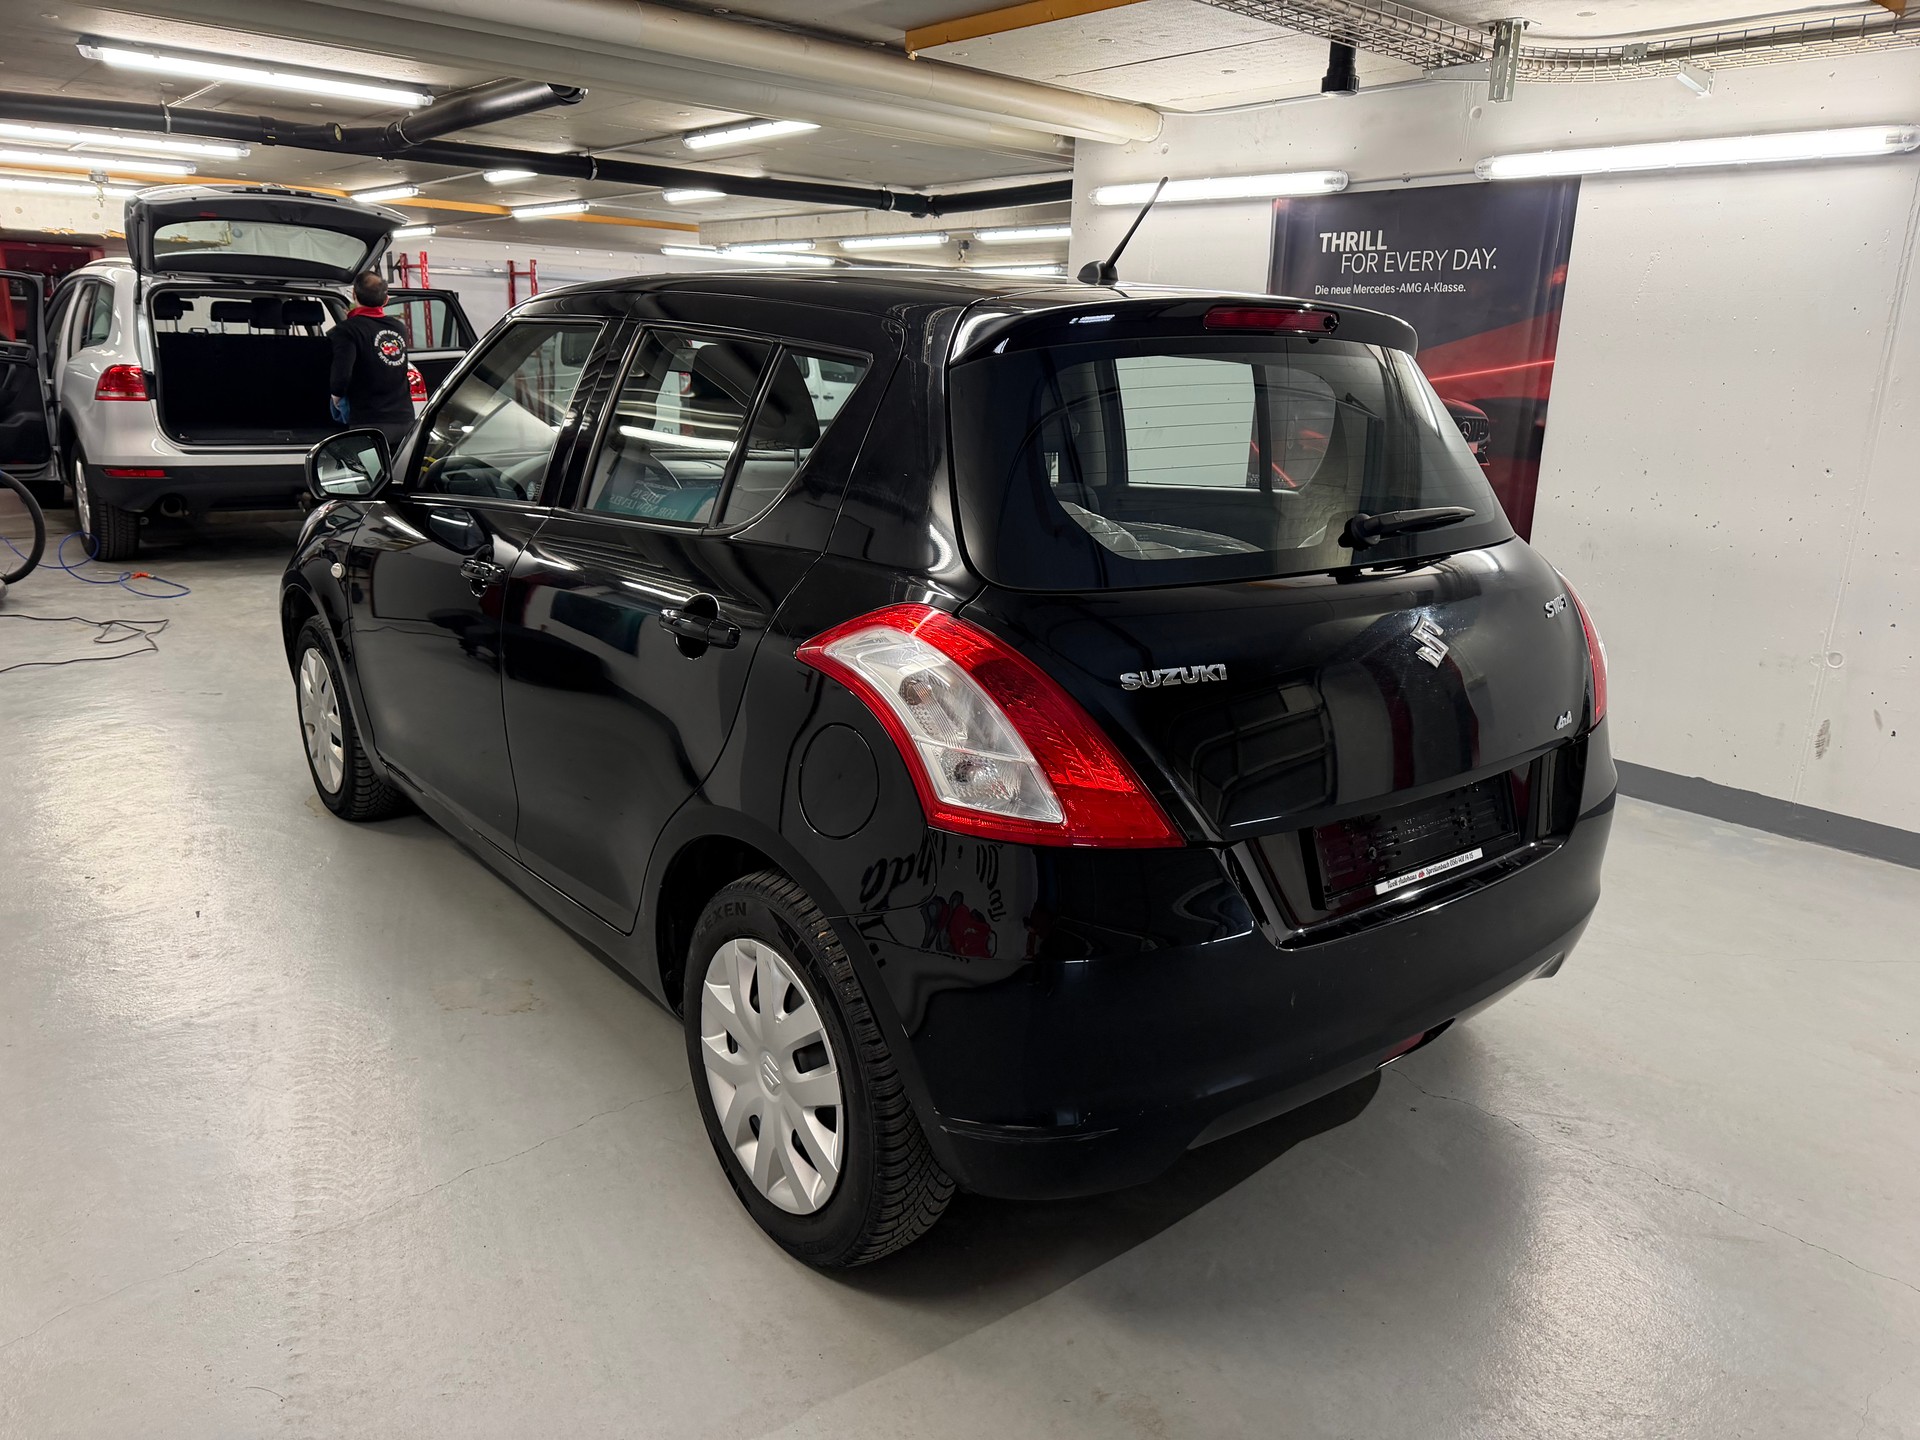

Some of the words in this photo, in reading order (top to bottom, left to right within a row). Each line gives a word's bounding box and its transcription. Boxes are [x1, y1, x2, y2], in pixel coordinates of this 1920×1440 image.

[1319, 229, 1388, 253] THRILL
[1341, 252, 1378, 274] FOR
[1383, 249, 1449, 273] EVERY
[1452, 247, 1497, 271] DAY.
[1315, 284, 1330, 295] Die
[1330, 284, 1352, 295] neue
[1423, 281, 1467, 293] A-Klasse.
[1120, 663, 1228, 691] SUZUKI
